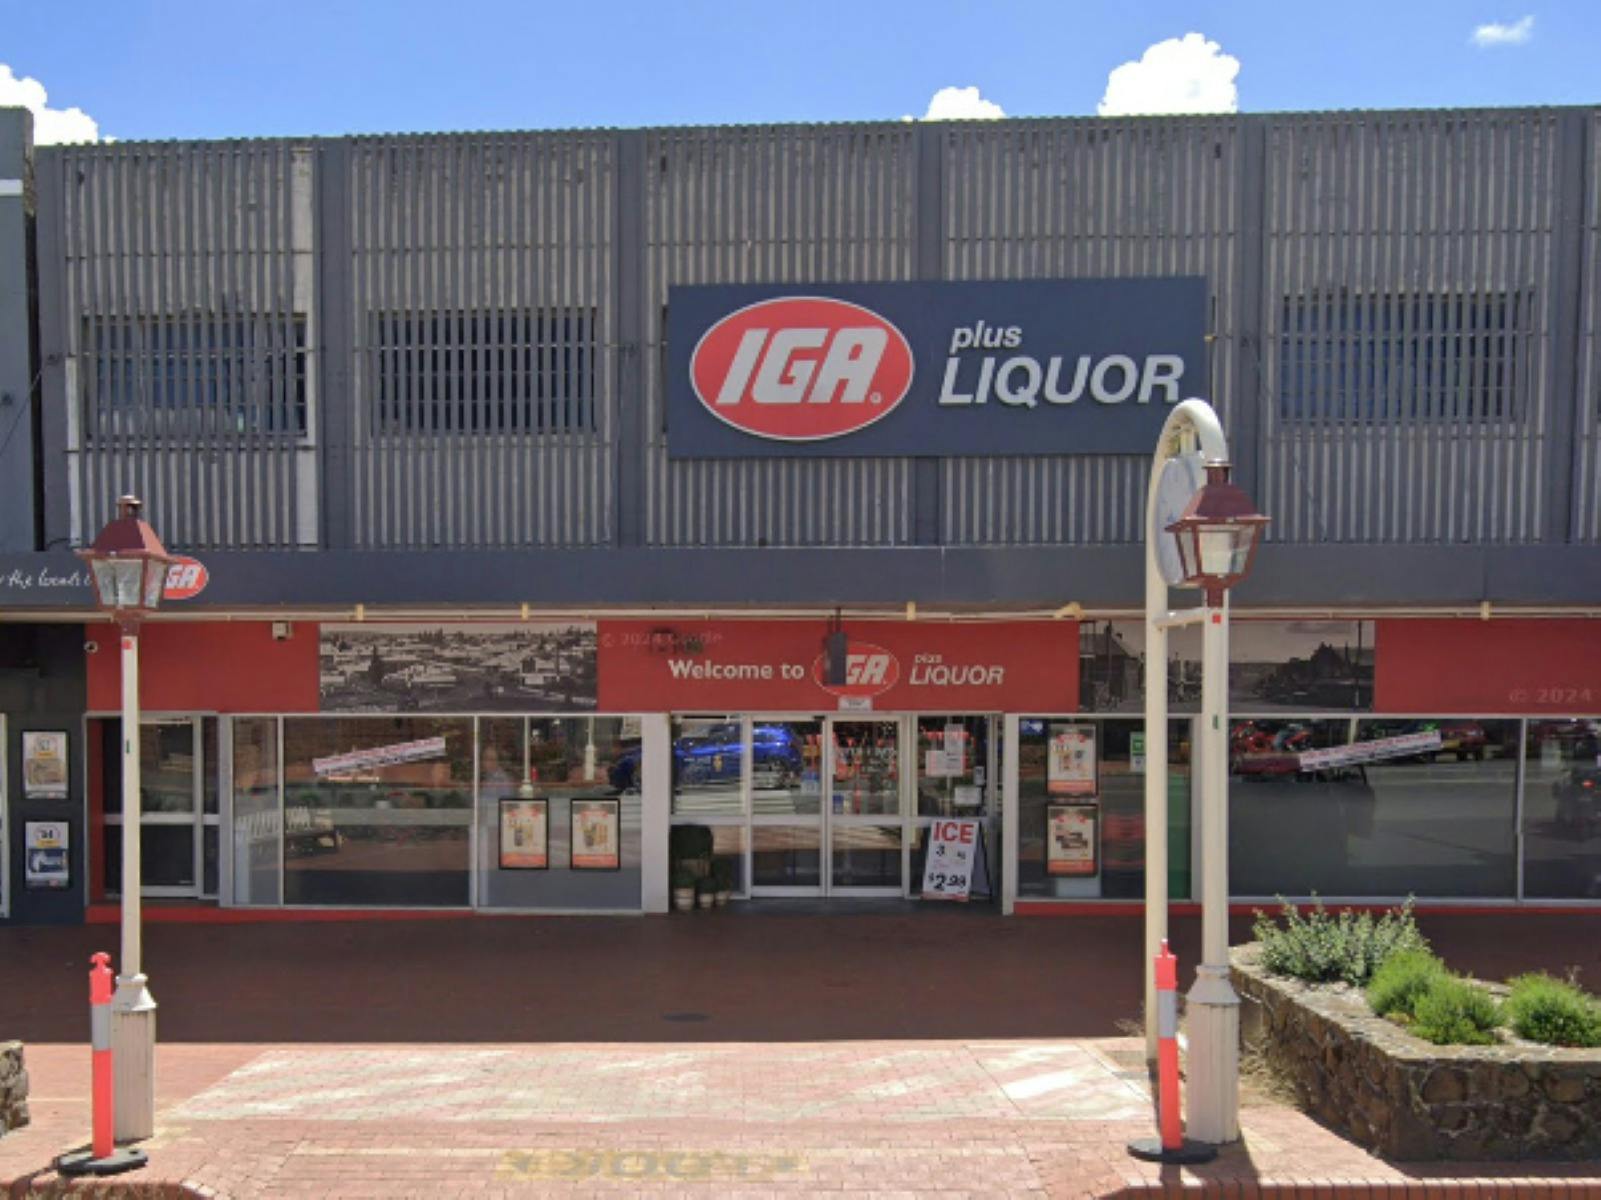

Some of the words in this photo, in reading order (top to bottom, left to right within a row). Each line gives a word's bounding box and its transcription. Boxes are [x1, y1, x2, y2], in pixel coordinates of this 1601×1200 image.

[949, 320, 1023, 354] plus
[938, 354, 1185, 407] LIQUOR
[165, 565, 202, 588] GA
[667, 658, 773, 680] Welcome
[781, 659, 805, 680] to
[845, 655, 889, 685] GA
[909, 665, 1005, 686] LIQUOR
[933, 822, 974, 844] ICE
